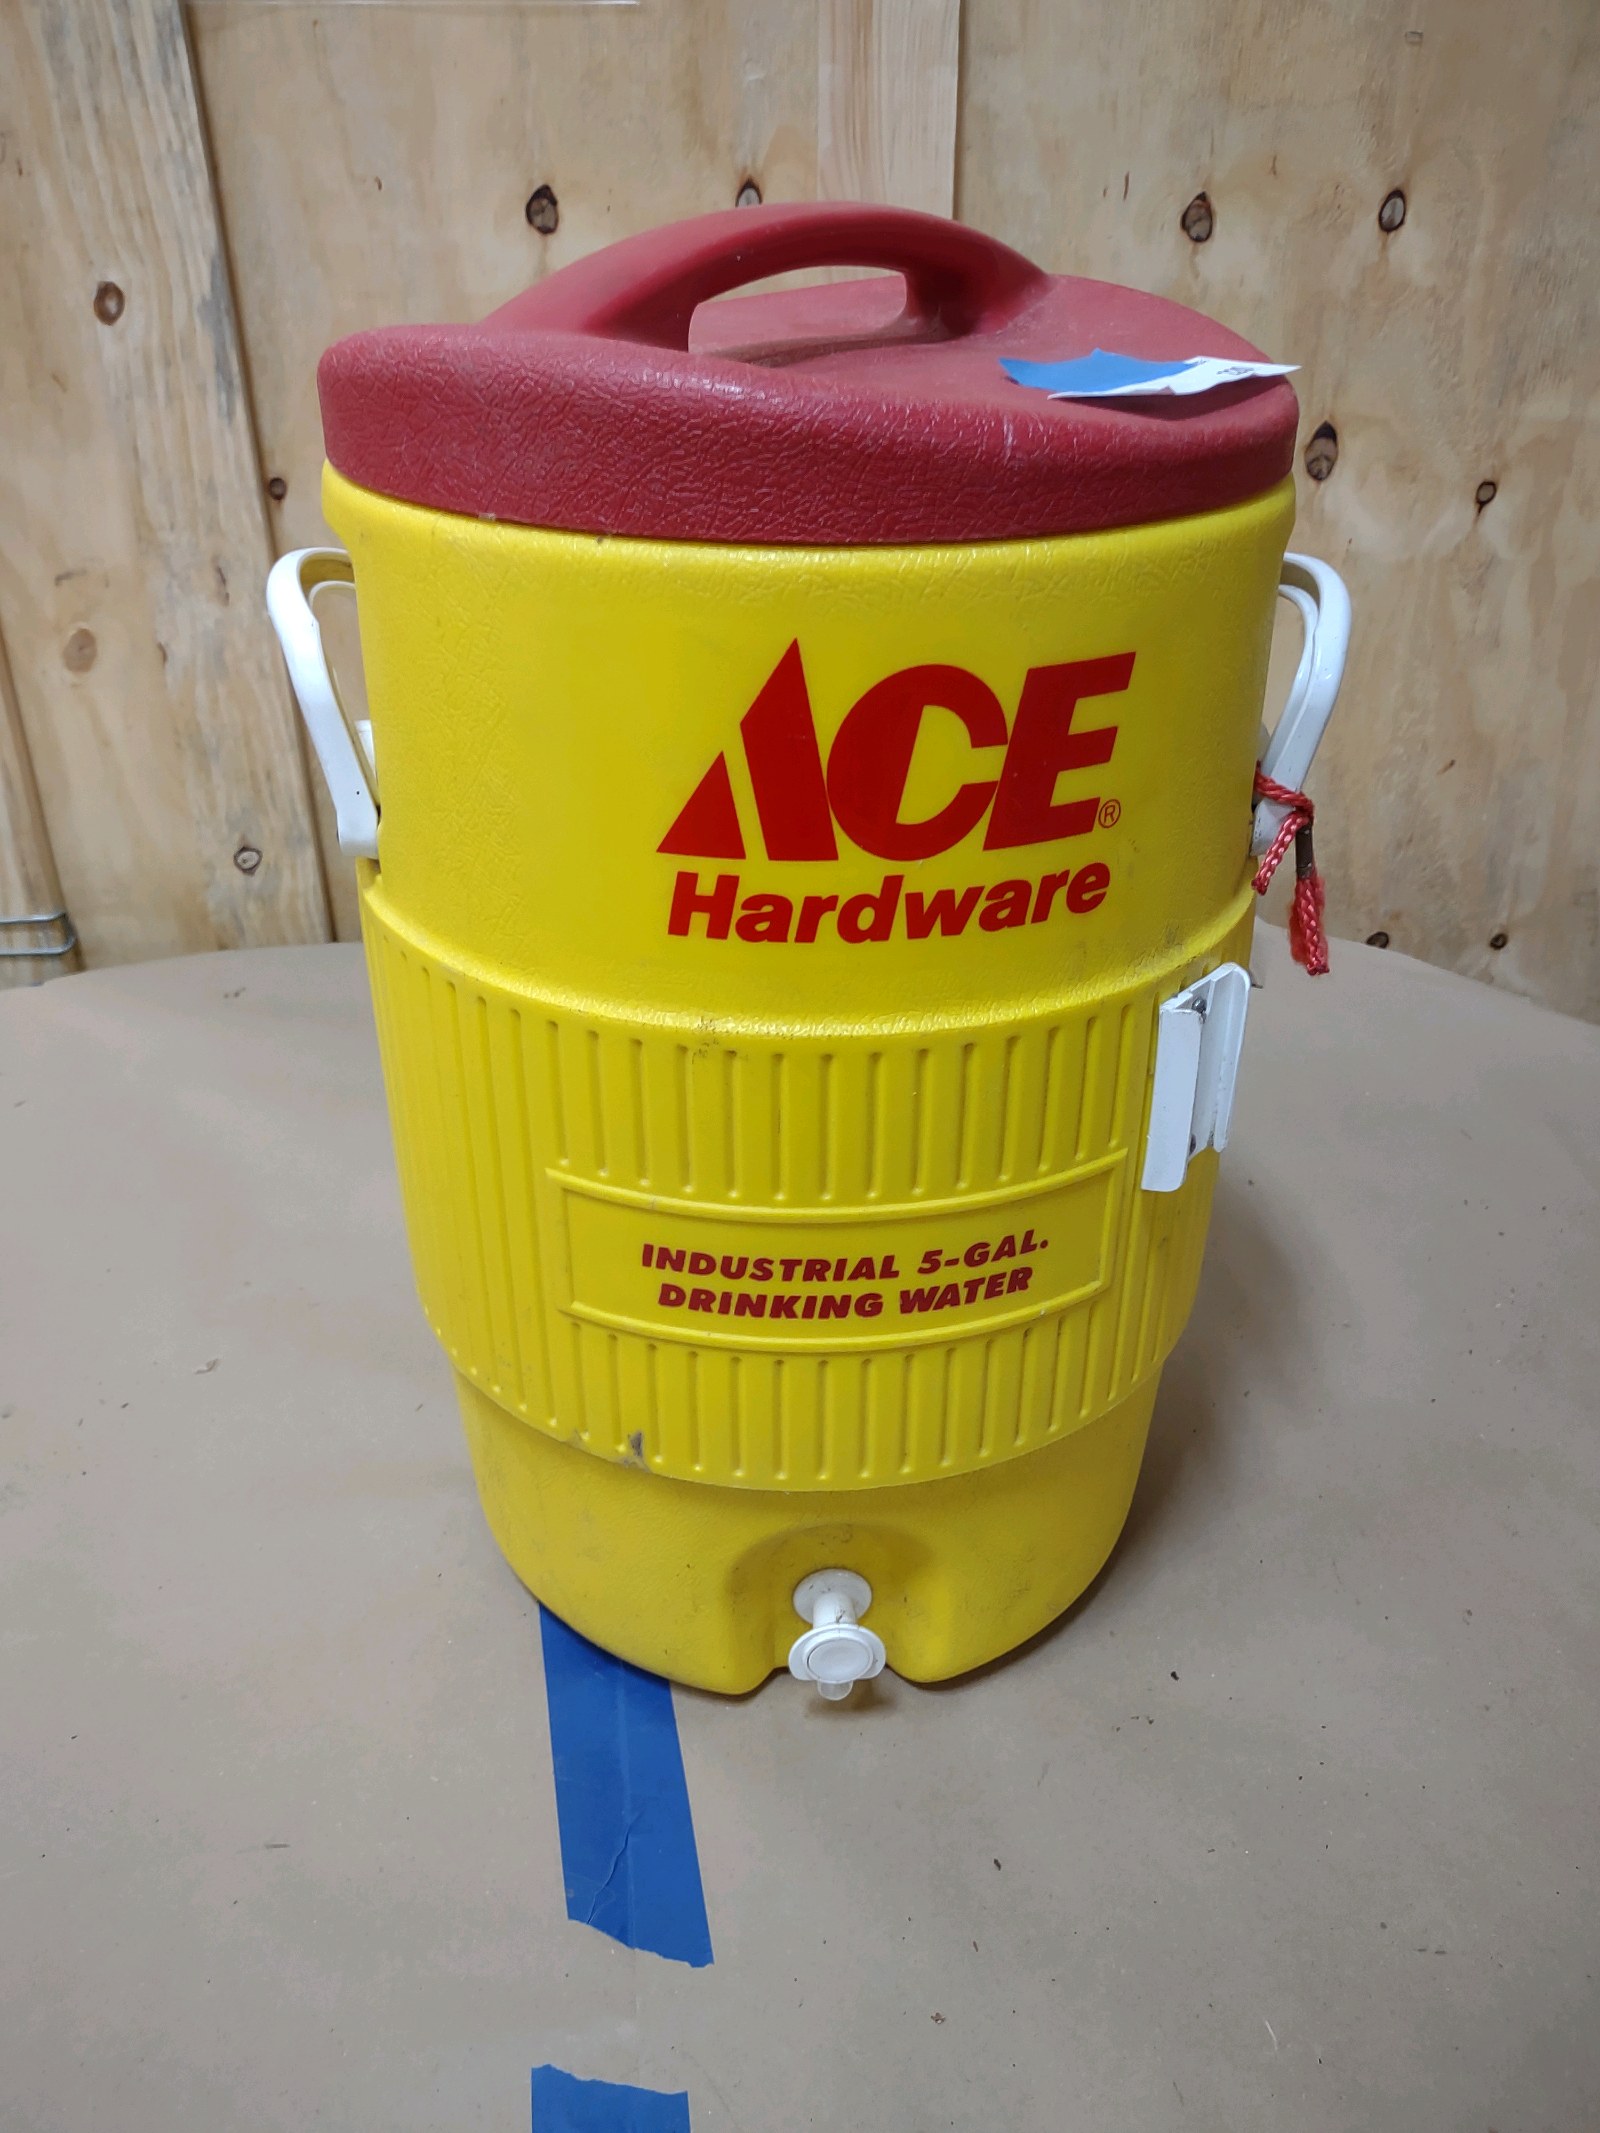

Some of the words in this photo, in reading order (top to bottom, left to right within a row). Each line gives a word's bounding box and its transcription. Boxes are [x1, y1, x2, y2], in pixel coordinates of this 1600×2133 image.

[656, 638, 1137, 862] ACE
[667, 862, 1111, 944] Hardware
[642, 1243, 900, 1282] INDUSTRIAL
[917, 1229, 1050, 1275] 5-GAL.
[658, 1283, 884, 1319] DRINKING
[900, 1266, 1034, 1314] WATER
